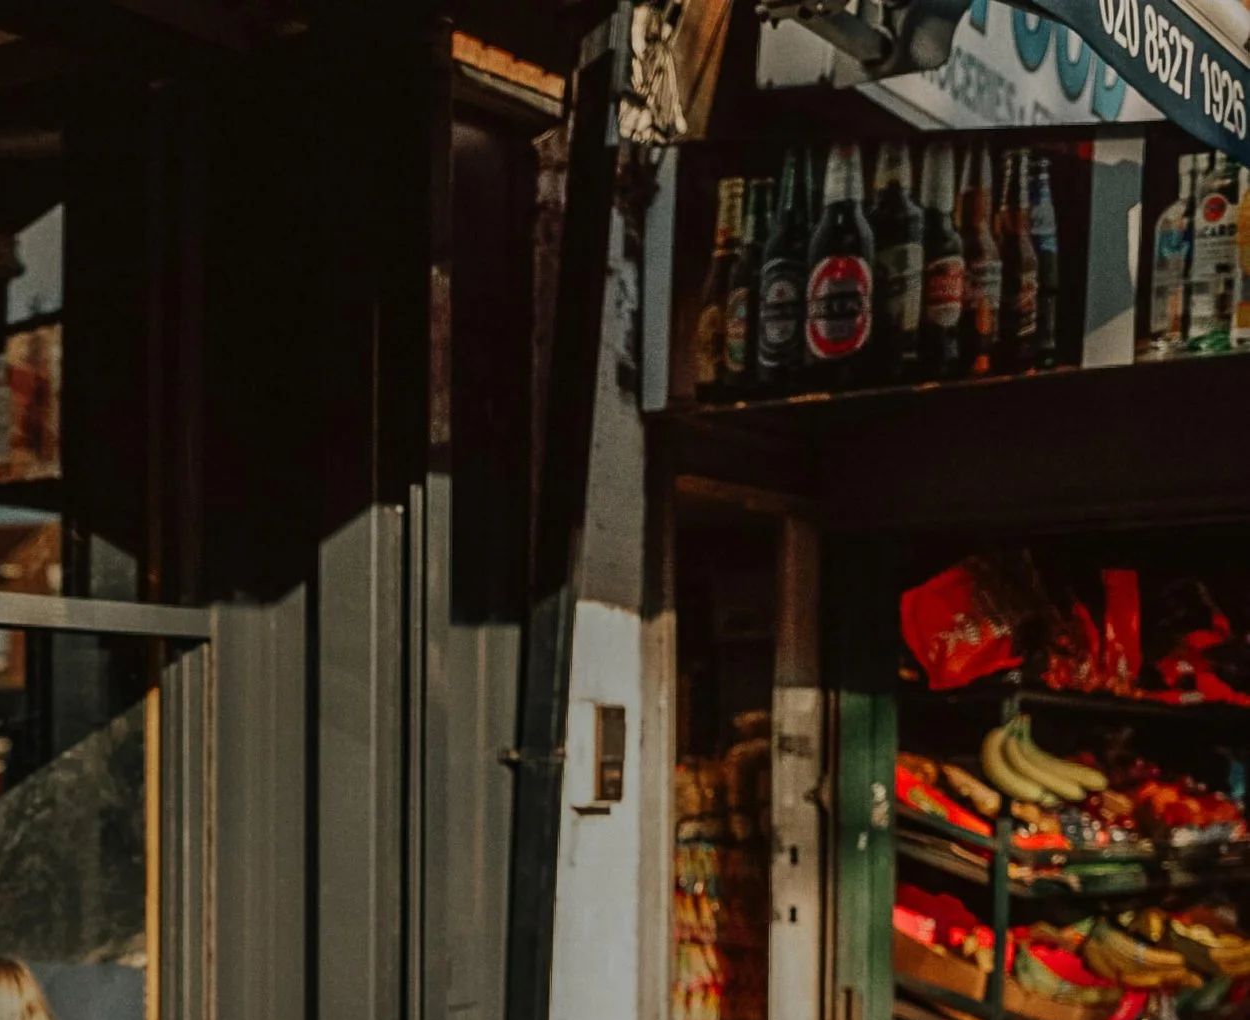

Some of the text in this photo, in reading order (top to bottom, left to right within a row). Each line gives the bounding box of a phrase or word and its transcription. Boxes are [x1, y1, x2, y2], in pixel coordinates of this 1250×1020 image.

[1100, 0, 1246, 139] 020 8527 1926
